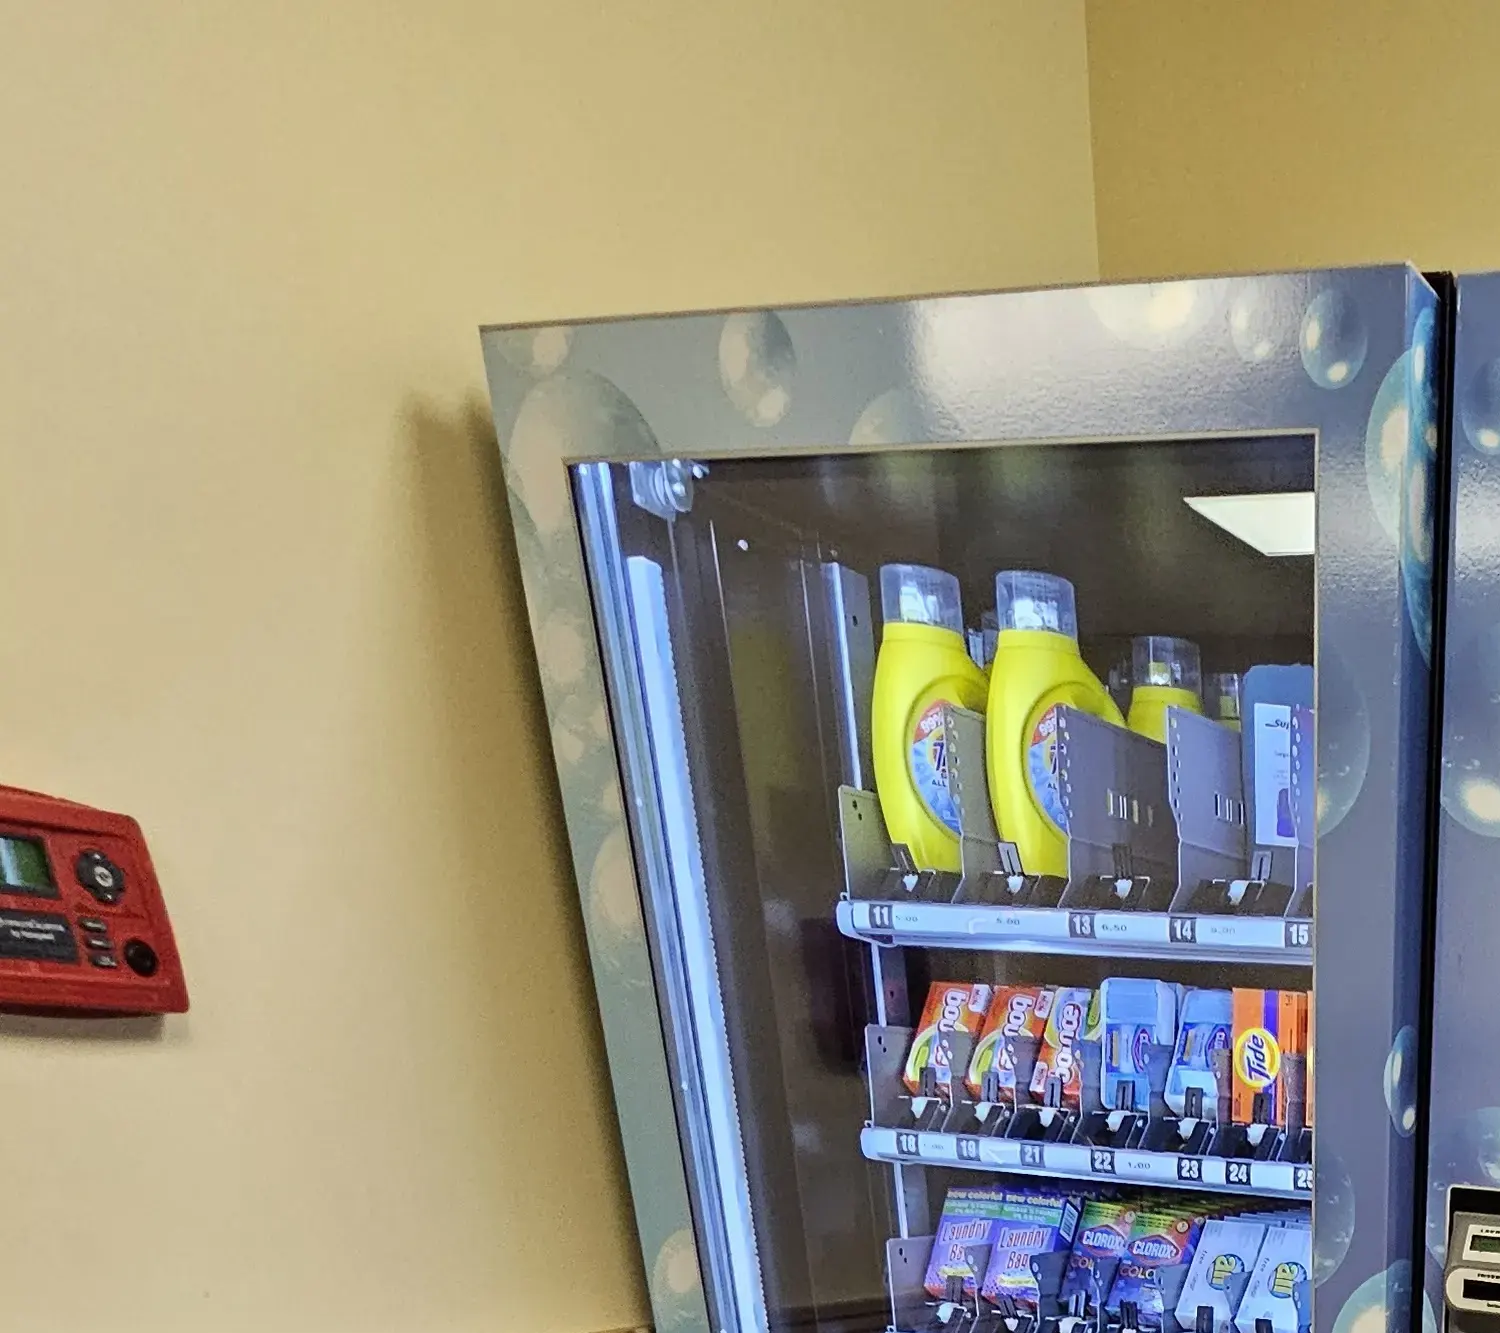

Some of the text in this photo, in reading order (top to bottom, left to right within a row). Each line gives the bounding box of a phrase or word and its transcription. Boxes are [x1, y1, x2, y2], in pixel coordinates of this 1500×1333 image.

[873, 906, 890, 926] 11
[1072, 914, 1092, 936] 13
[1101, 923, 1128, 933] 6.50
[1173, 920, 1192, 940] 14
[1289, 925, 1309, 945] 15
[1243, 1034, 1272, 1083] Tide
[899, 1134, 916, 1153] 18
[960, 1138, 977, 1158] 19
[1023, 1145, 1041, 1165] 21
[1093, 1152, 1112, 1172] 22
[1180, 1160, 1200, 1180] 23
[1228, 1164, 1249, 1184] 24
[1297, 1169, 1313, 1189] 25
[943, 1219, 990, 1242] Laundry
[1000, 1228, 1049, 1249] Laundry
[1121, 1265, 1156, 1280] COLO
[1275, 1262, 1299, 1293] all
